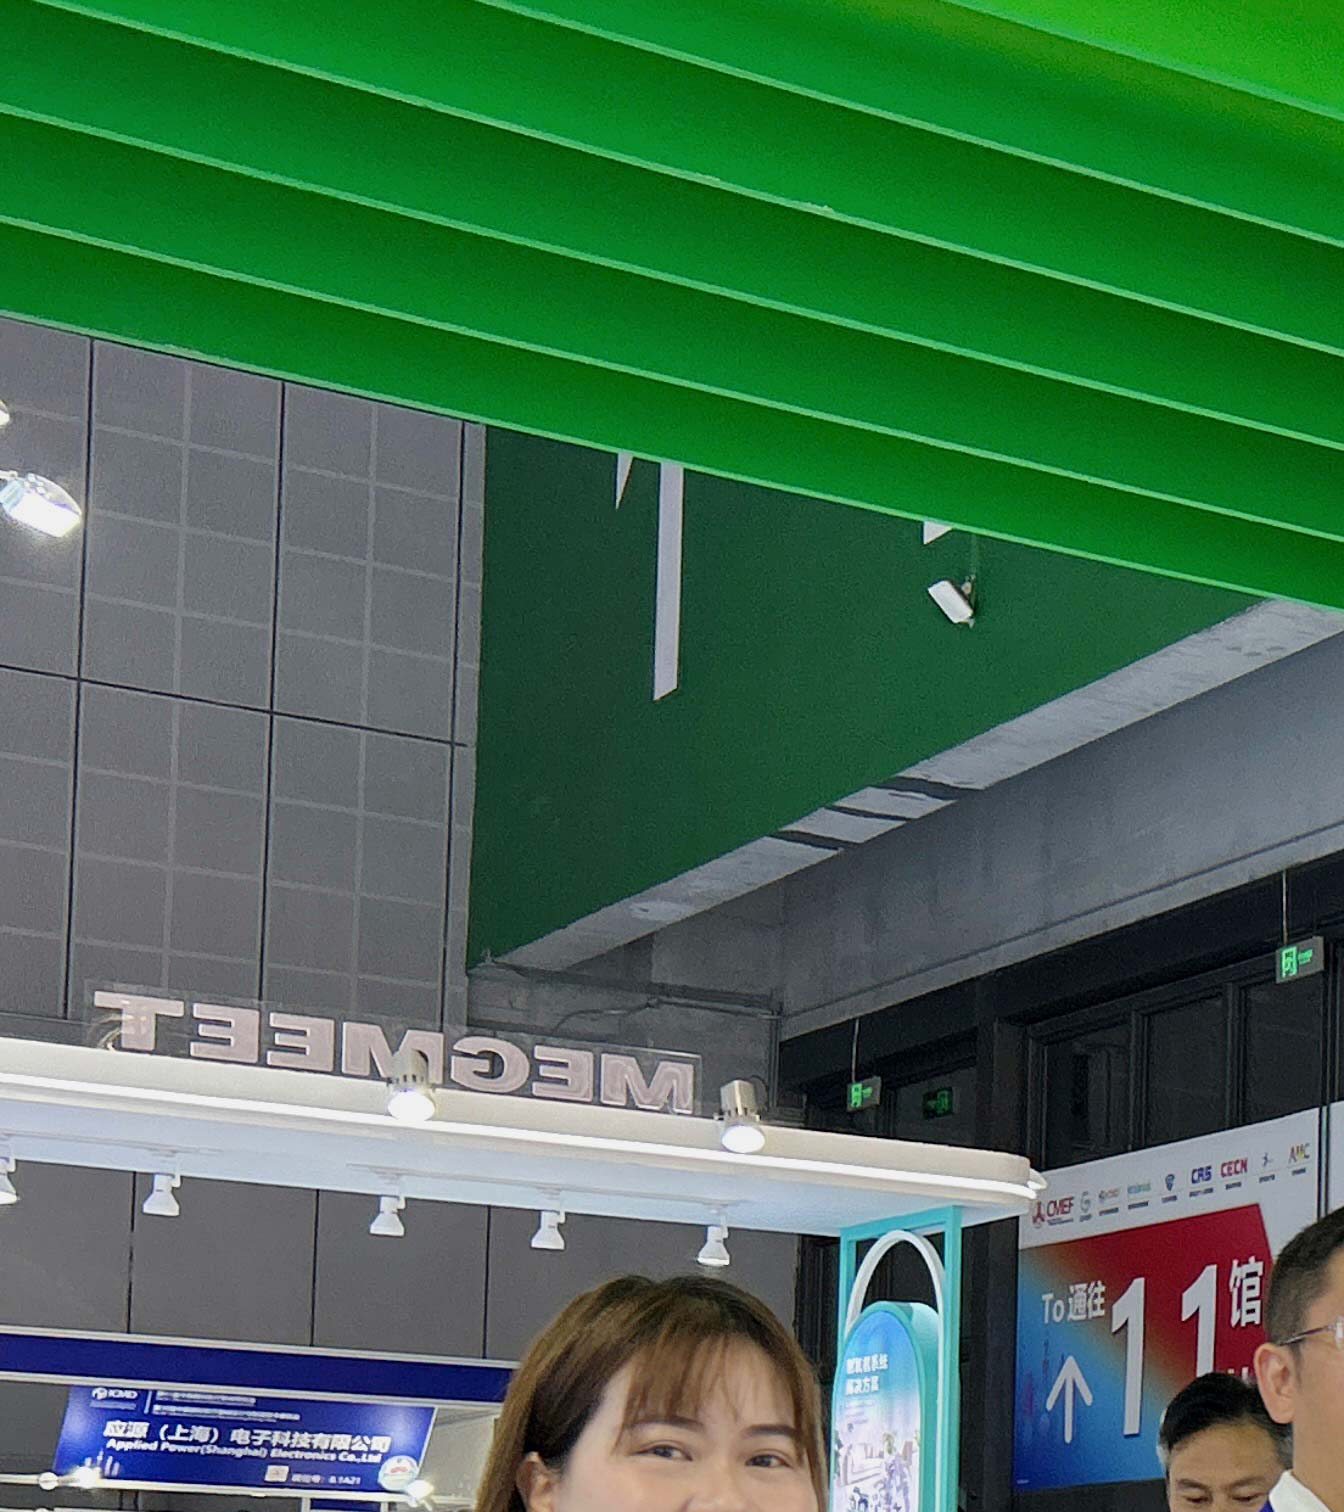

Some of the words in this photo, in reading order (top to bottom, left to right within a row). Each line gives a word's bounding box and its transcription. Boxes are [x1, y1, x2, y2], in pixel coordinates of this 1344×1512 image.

[1042, 1292, 1065, 1324] To
[1068, 1281, 1106, 1322] 通往
[1228, 1255, 1264, 1329] 馆
[106, 1438, 157, 1452] Applied
